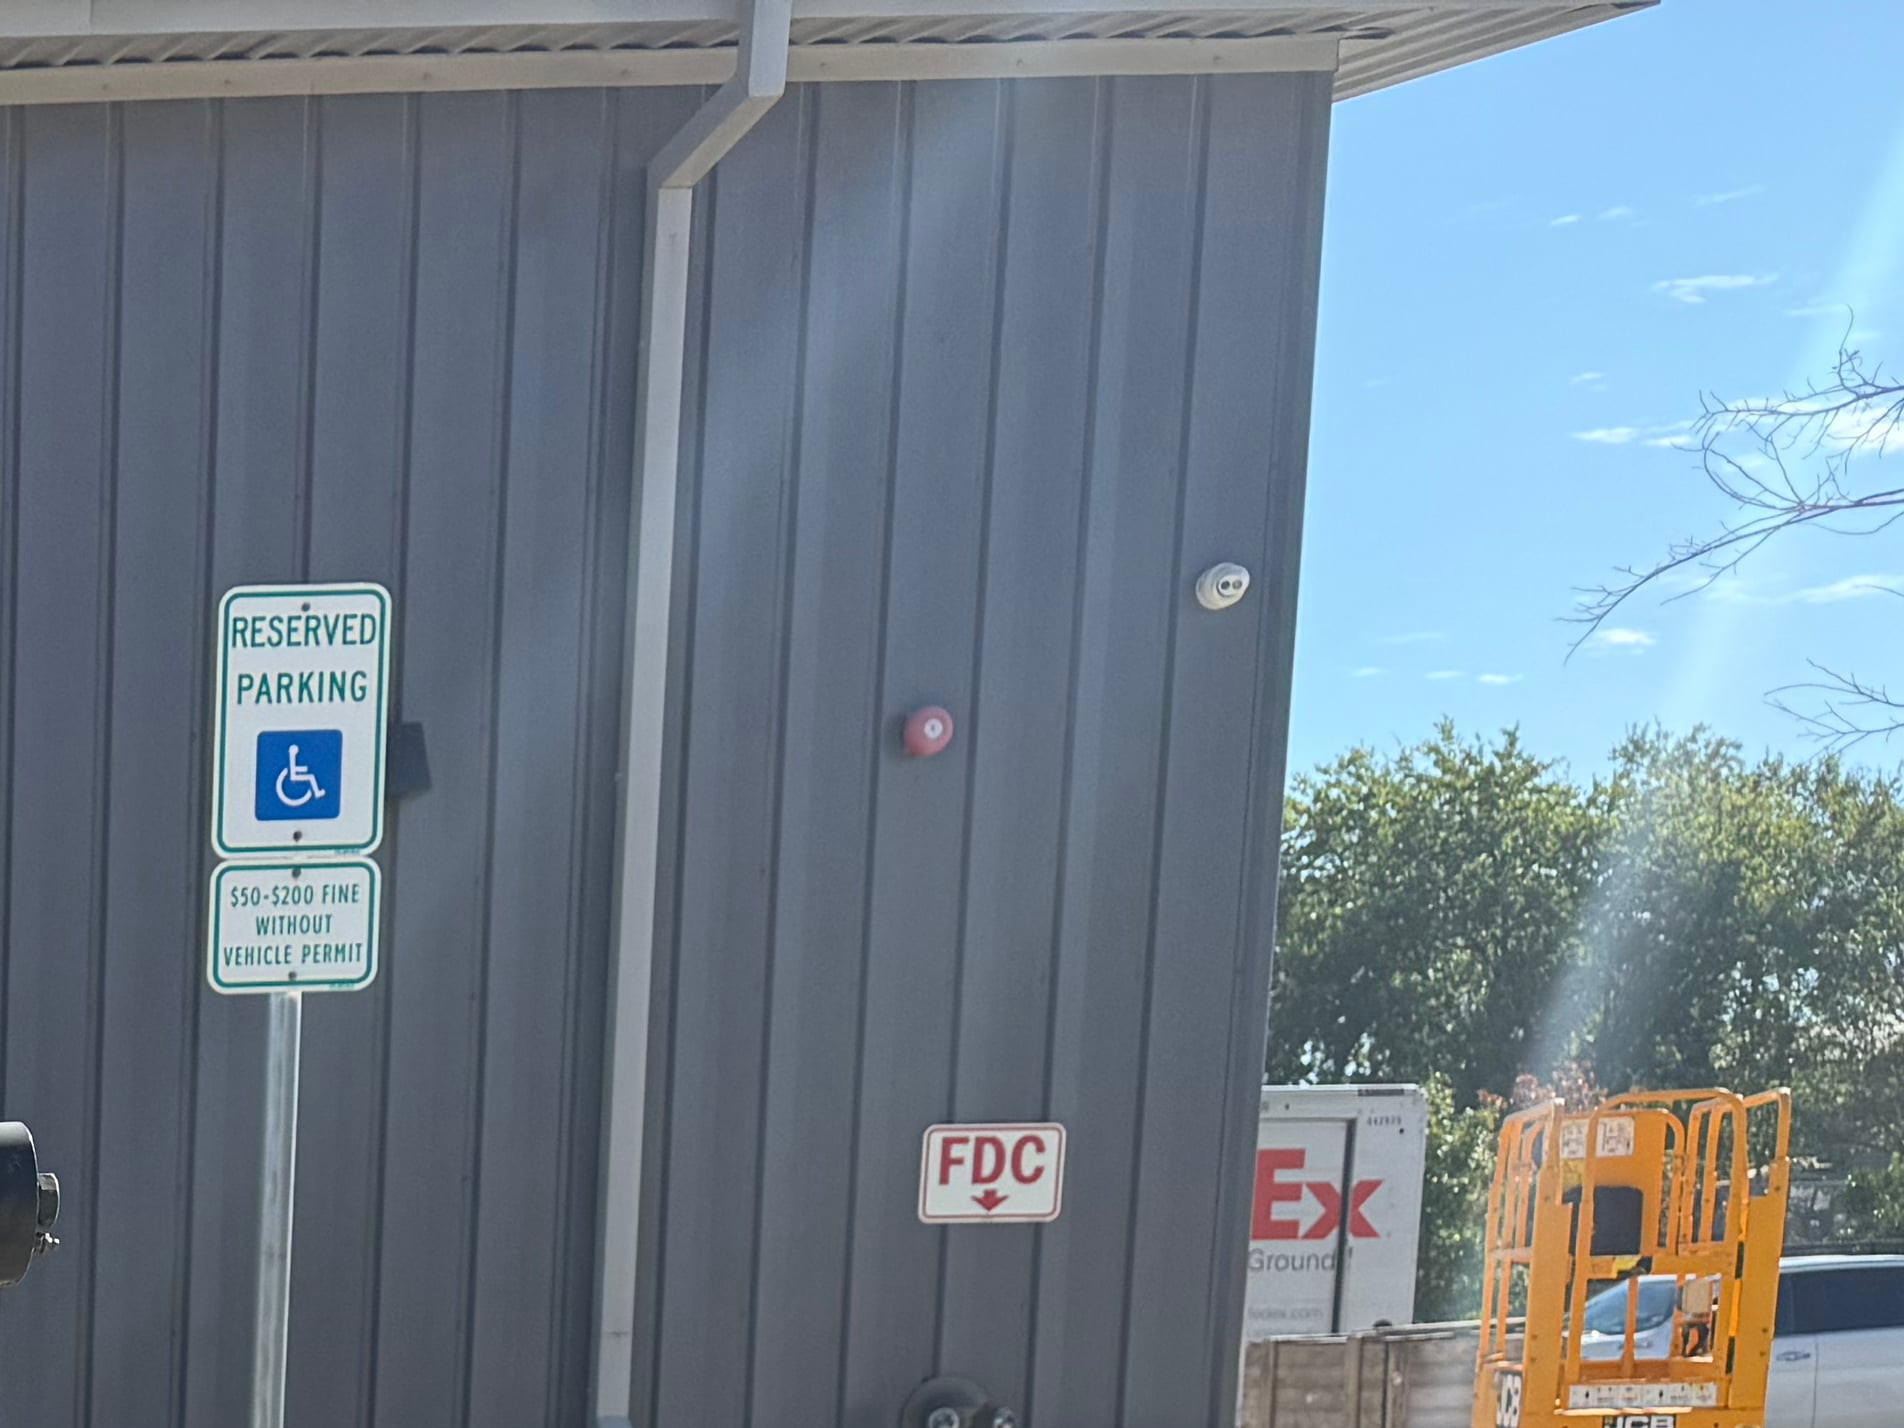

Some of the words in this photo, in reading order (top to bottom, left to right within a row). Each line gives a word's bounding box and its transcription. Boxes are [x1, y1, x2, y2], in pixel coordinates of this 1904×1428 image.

[231, 613, 376, 648] RESERVED
[237, 670, 367, 705] PARKING
[231, 884, 314, 907] $50-$200
[323, 883, 360, 904] FINE
[256, 913, 333, 935] WITHOUT
[223, 945, 292, 967] VEHICLE
[302, 943, 362, 964] PERMIT
[938, 1134, 1046, 1186] FDC
